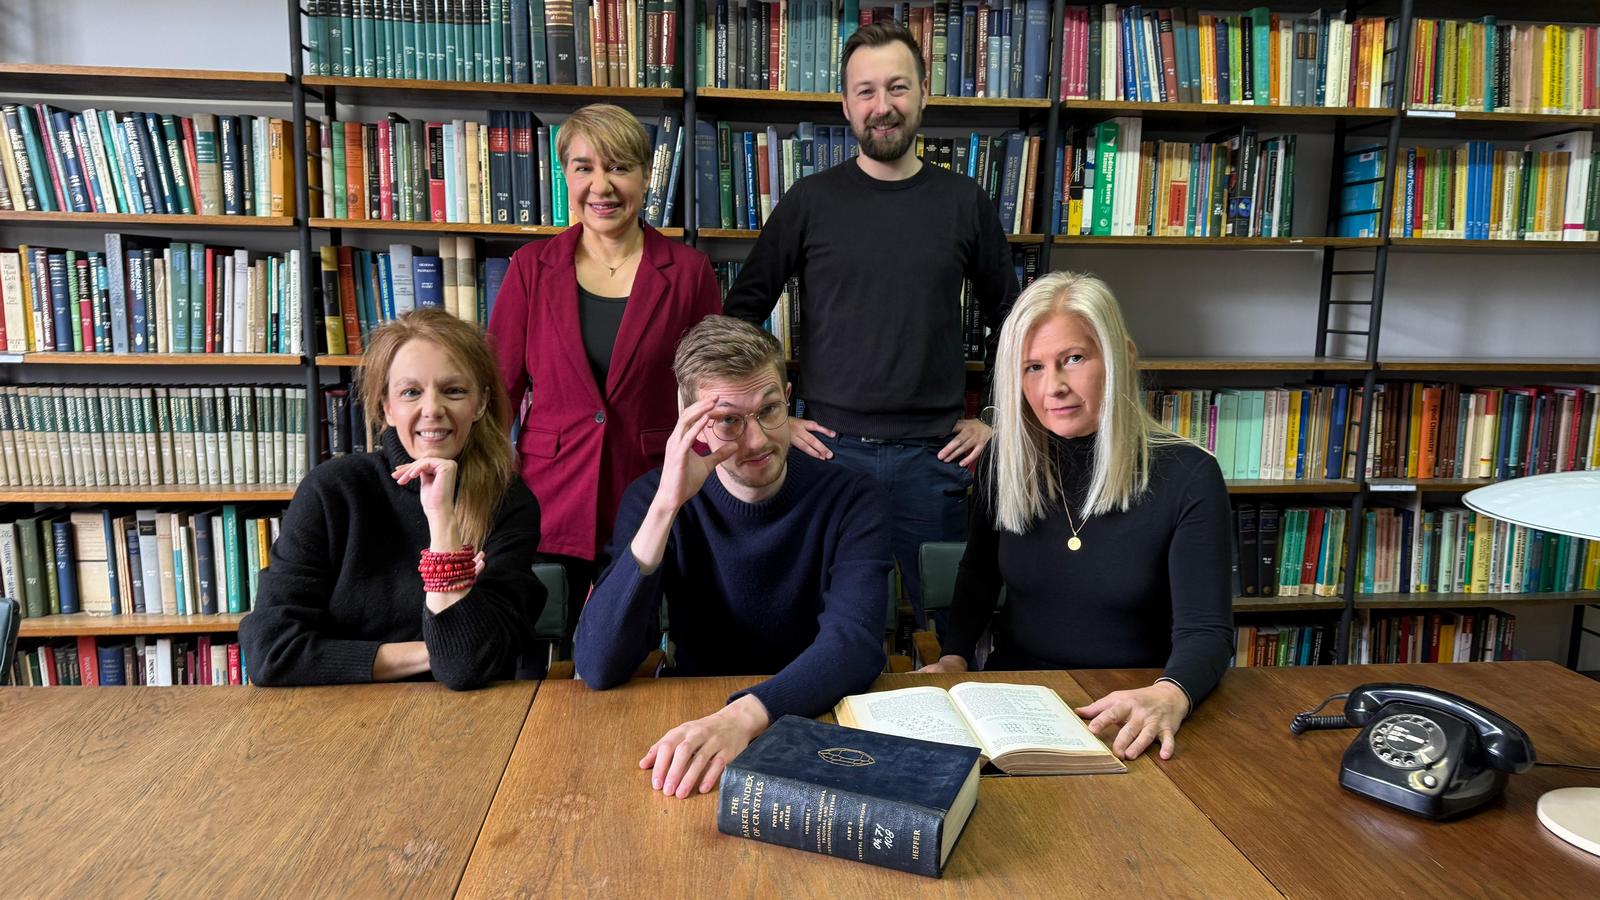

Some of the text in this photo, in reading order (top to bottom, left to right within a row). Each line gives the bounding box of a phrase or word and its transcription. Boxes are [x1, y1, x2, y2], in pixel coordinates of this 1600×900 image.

[1106, 152, 1114, 181] Radiology
[1407, 153, 1415, 178] Quantity
[1427, 421, 1435, 452] Chemistry
[731, 797, 739, 815] THE
[741, 774, 754, 837] BARKER INDEX
[753, 781, 764, 837] OF CRYSTALS
[828, 794, 836, 816] SYSTEMS
[858, 803, 867, 840] DESCRIPTIONS
[884, 829, 895, 849] 108
[912, 829, 921, 860] HEFFER
